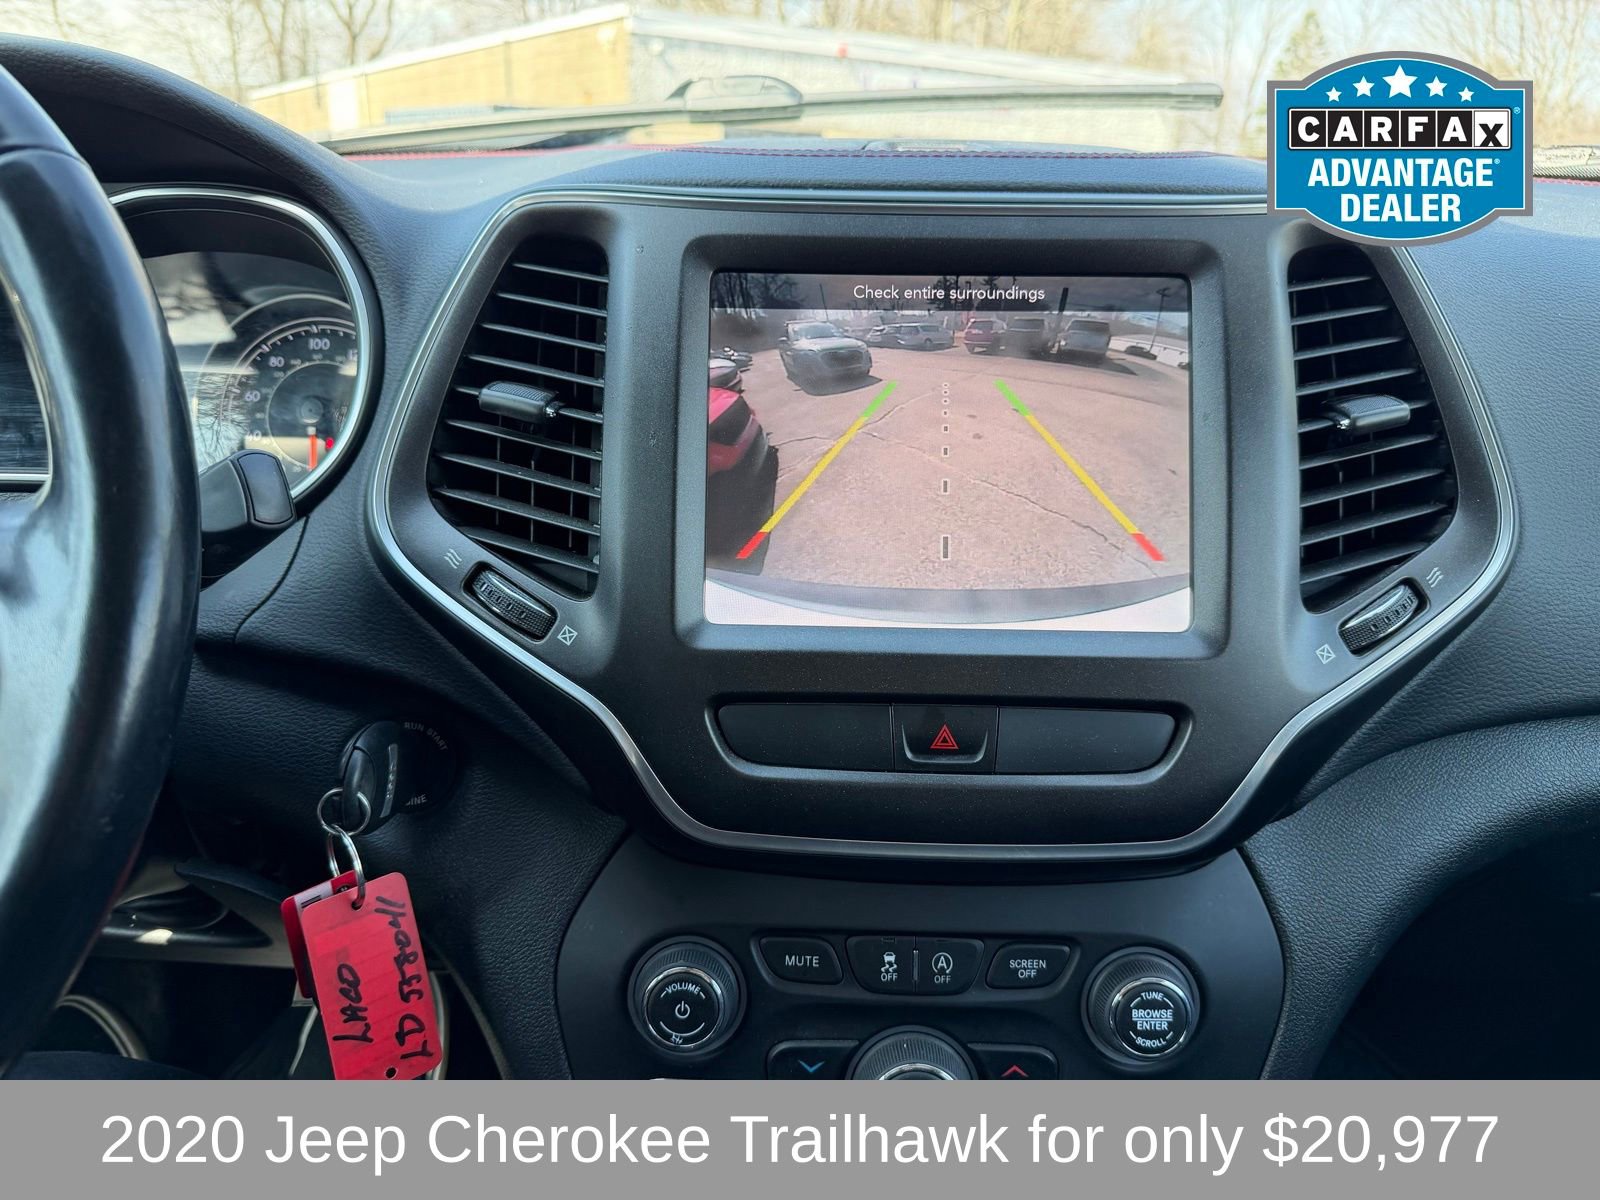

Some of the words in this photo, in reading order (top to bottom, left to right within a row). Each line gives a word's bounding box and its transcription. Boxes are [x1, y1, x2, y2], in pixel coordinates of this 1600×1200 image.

[853, 285, 900, 299] Check
[904, 286, 945, 299] entire
[949, 285, 1046, 303] surroundings
[308, 338, 330, 350] 100
[269, 356, 285, 367] 80
[245, 391, 261, 402] 60
[404, 721, 424, 731] RUN
[785, 955, 819, 967] MUTE
[1009, 959, 1046, 969] SCREEN
[880, 972, 898, 982] OFF
[1018, 969, 1037, 979] OFF
[934, 975, 951, 984] OFF
[665, 982, 701, 995] VOLUME
[1140, 991, 1165, 1001] TUNE
[1131, 1009, 1173, 1019] BROWSE
[1136, 1021, 1169, 1031] ENTER
[1135, 1036, 1167, 1048] SCROLL
